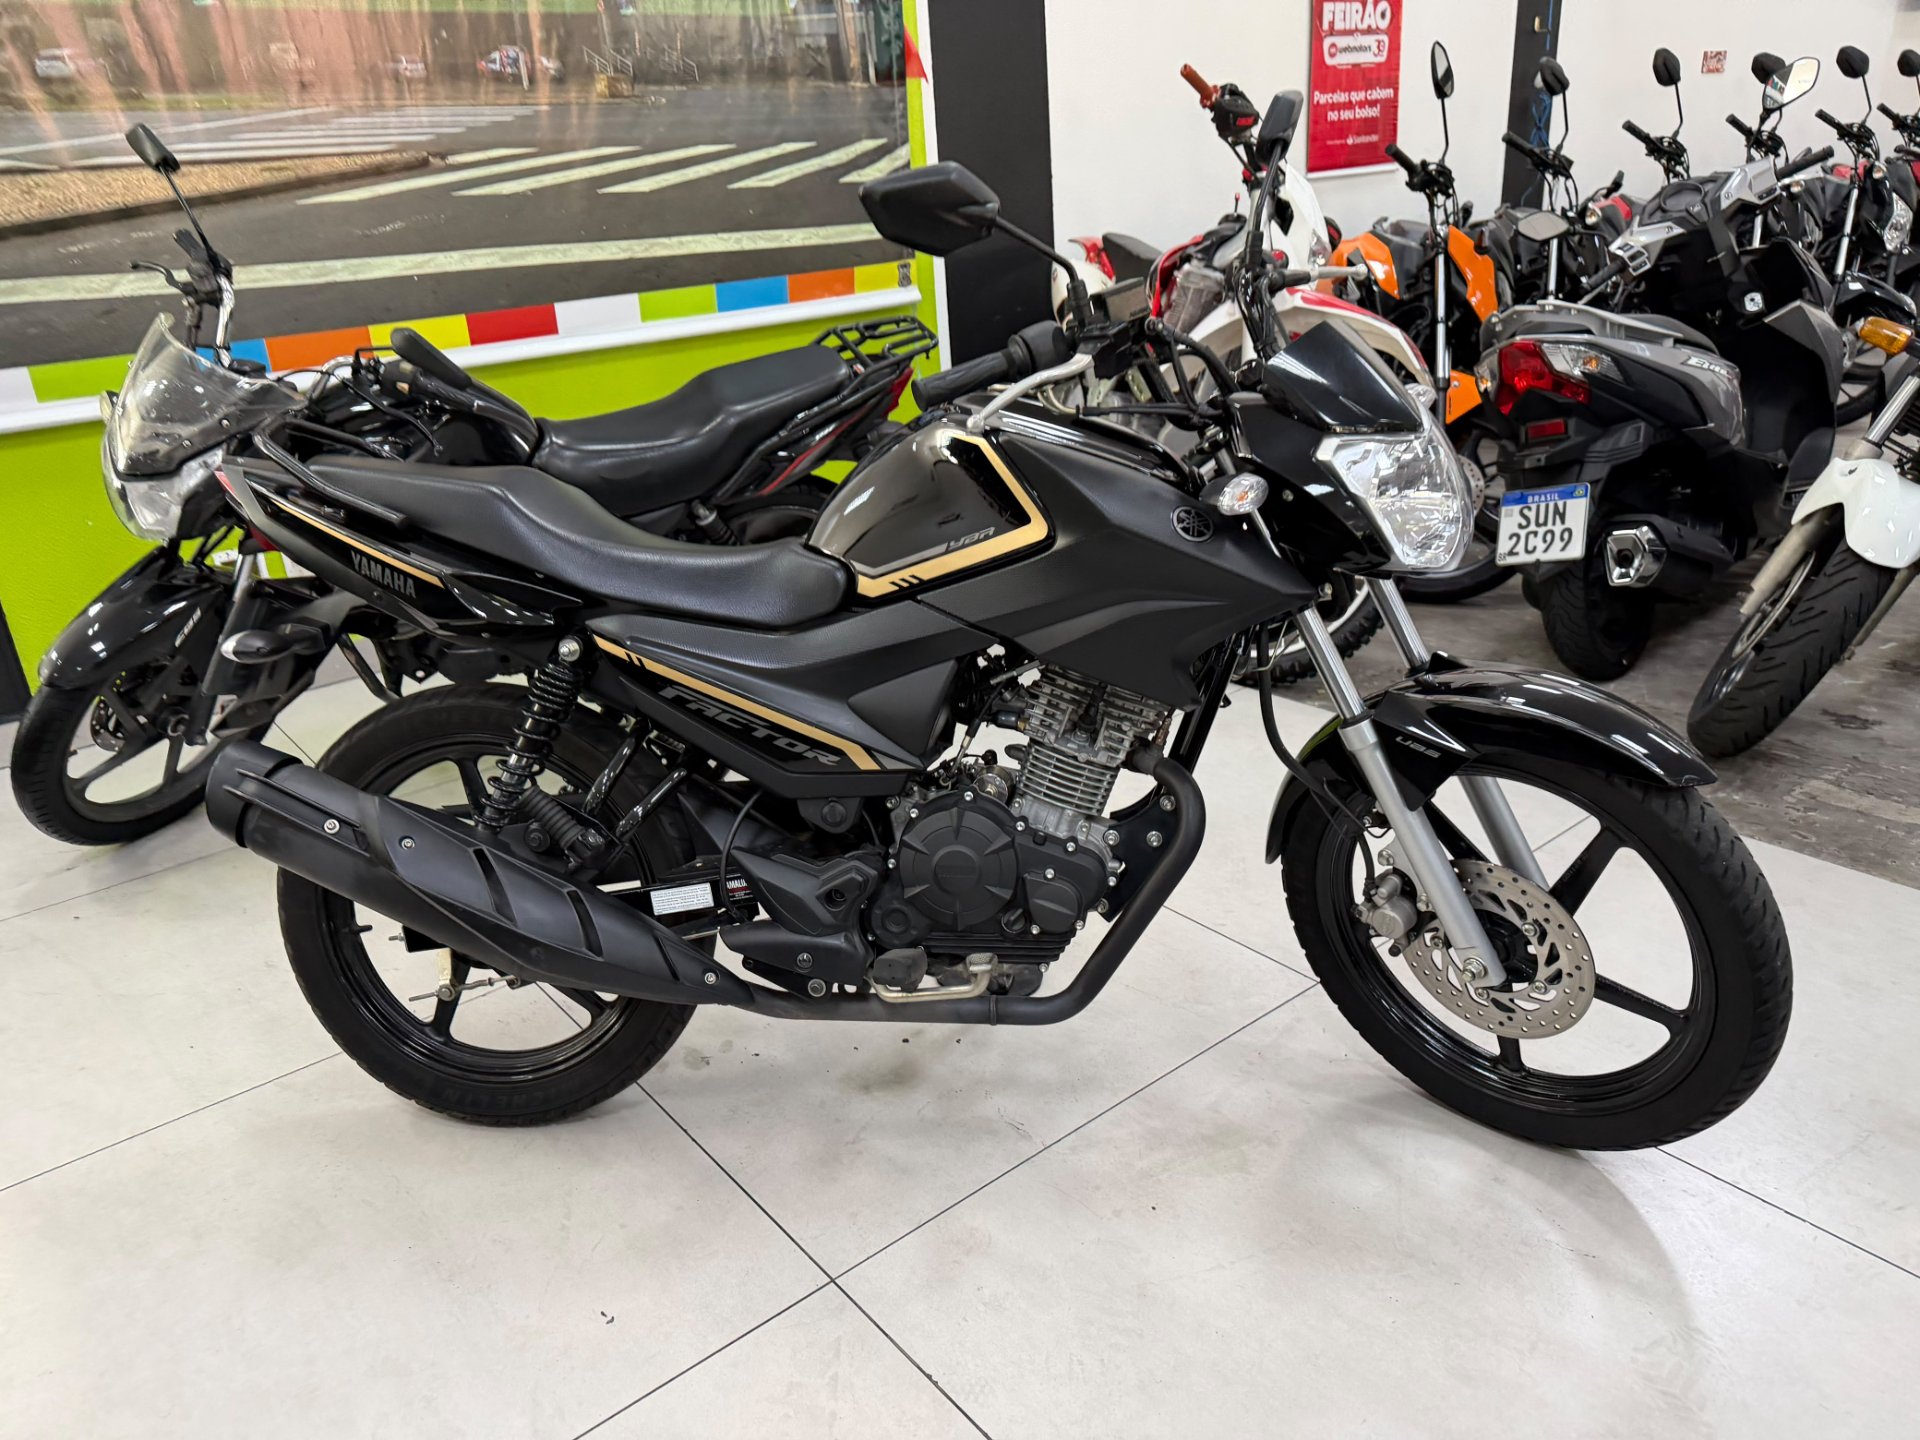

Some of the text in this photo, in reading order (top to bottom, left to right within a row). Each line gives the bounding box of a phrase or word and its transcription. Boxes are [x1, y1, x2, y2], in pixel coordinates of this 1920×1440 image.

[1314, 86, 1394, 105] Parcelas que cabem
[1327, 104, 1380, 122] no seu bolso!
[1527, 492, 1559, 504] BRASIL
[1517, 500, 1567, 530] SUN
[1507, 527, 1573, 556] 2C99
[350, 548, 416, 599] YAMAHA
[658, 685, 842, 766] FACTOR
